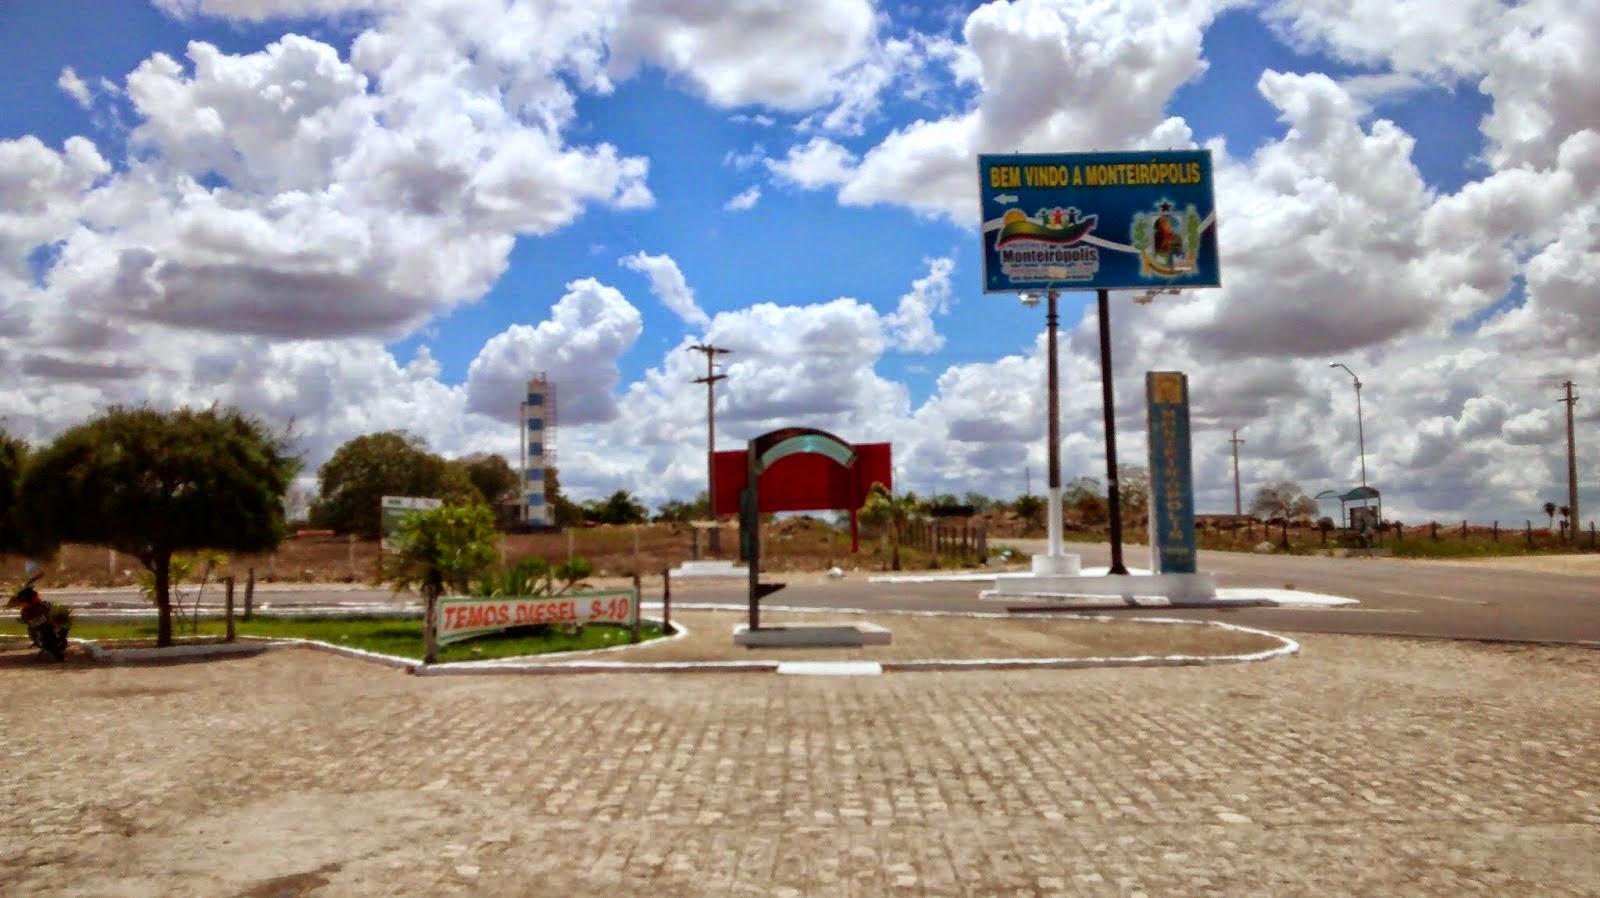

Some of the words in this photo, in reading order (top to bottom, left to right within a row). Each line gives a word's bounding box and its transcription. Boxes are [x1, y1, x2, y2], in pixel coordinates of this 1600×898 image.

[990, 166, 1021, 187] BEM
[1025, 166, 1068, 186] VINDO
[1073, 166, 1082, 185] A
[1086, 159, 1200, 184] MONTEIRÓPOLIS
[444, 603, 509, 630] TEMOS
[514, 602, 576, 624] DIESEL
[591, 598, 628, 620] S-10
